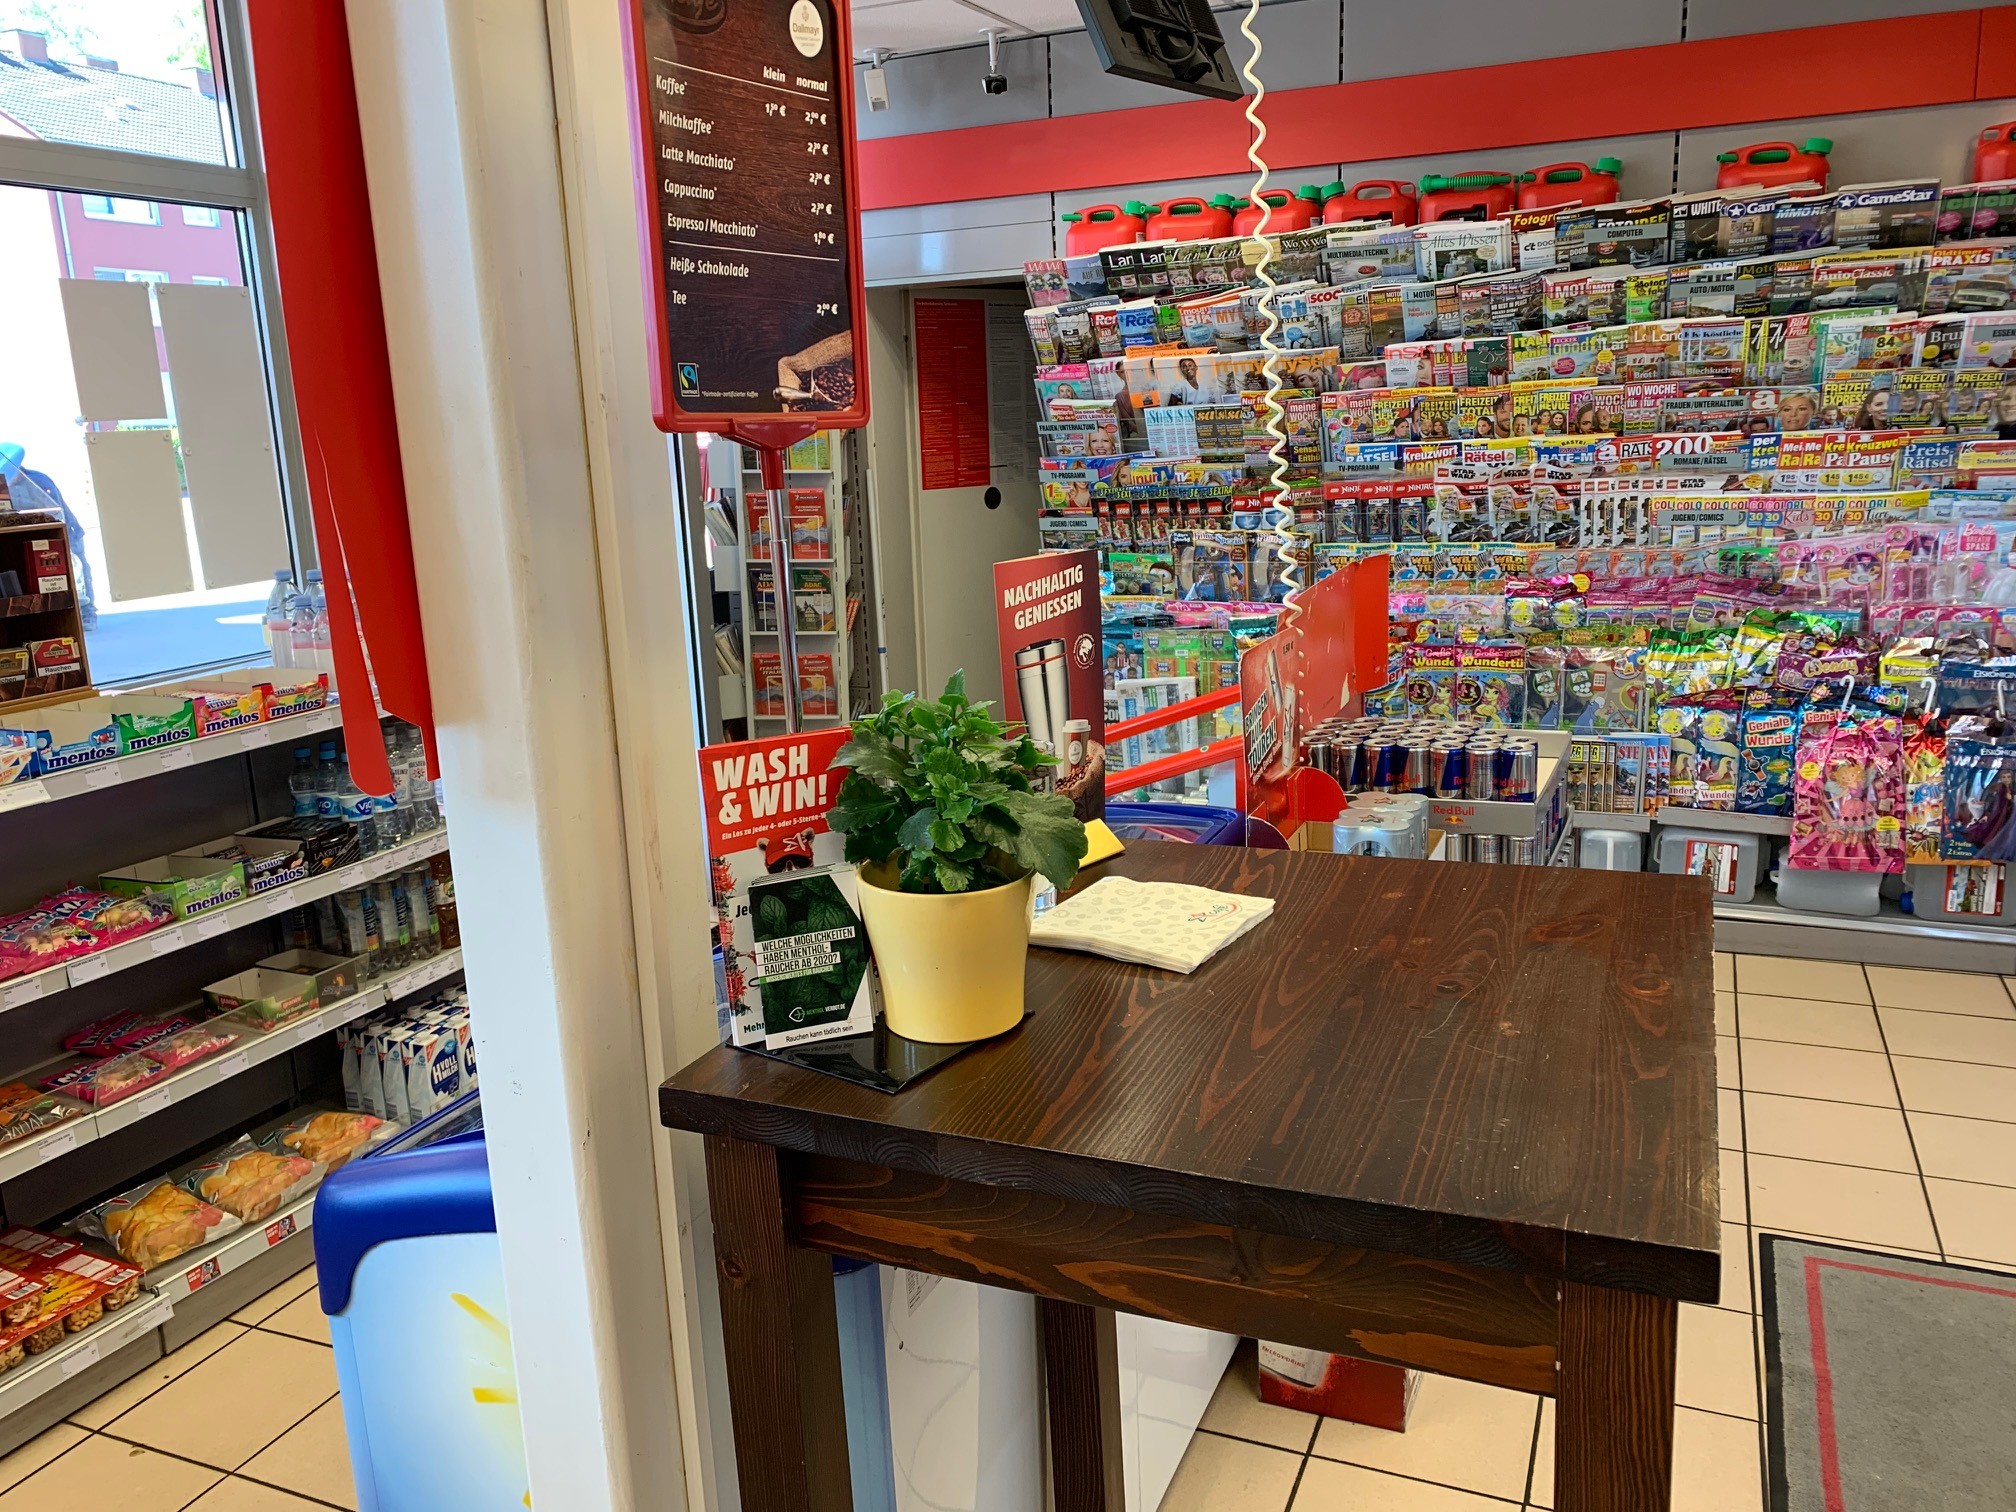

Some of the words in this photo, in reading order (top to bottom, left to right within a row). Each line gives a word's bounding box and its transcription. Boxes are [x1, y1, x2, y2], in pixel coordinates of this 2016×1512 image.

[792, 22, 820, 36] Dallmayr
[763, 65, 786, 83] klein
[796, 75, 828, 93] normal
[661, 144, 684, 163] Latte
[1858, 189, 1933, 207] GameStar
[1691, 200, 1722, 214] WHITE
[1607, 228, 1644, 239] COMPUTER
[1421, 235, 1455, 249] Altes
[1459, 234, 1499, 247] Wissen
[1326, 247, 1390, 259] MULTIMEDIA/TECHNIK
[1570, 247, 1589, 256] DOOM
[1932, 253, 1992, 266] PRAXIS
[670, 256, 695, 275] Heiße
[697, 259, 749, 278] Schokolade
[1413, 290, 1435, 299] MOTOR
[1689, 284, 1735, 294] AUTO/MOTOR
[672, 290, 687, 305] Tee
[1066, 301, 1112, 312] GRAVEL-SPEZIAL
[1789, 317, 1808, 328] Bild
[1876, 337, 1895, 348] 84
[1687, 366, 1742, 375] Blechkuchen
[1900, 373, 1947, 383] FREIZEIT
[1956, 372, 2004, 383] FREIZEIT
[1644, 383, 1677, 396] WOCHE
[1824, 382, 1870, 394] FREIZEIT
[1322, 395, 1336, 404] Lisa
[1539, 392, 1571, 402] FREIZEIT
[1290, 403, 1316, 412] meine
[1373, 399, 1411, 410] FREIZEIT
[1420, 401, 1457, 411] FREIZEIT
[1460, 406, 1495, 416] TOTAL
[1539, 401, 1571, 411] REVUE
[1665, 399, 1744, 410] FRAUEN/UNTERHALTUNG
[1289, 411, 1318, 421] WOCHE
[1420, 410, 1457, 420] SPASS
[1039, 423, 1096, 433] FRAUEN/UNTERHALTUNG
[1753, 436, 1777, 447] Der
[1403, 445, 1458, 461] Kreuzwort
[1465, 450, 1505, 463] Rätsel
[1904, 443, 1954, 457] Preis-
[1673, 455, 1728, 466] ROMANE/RÄTSEL
[1902, 455, 1955, 469] Rätsel
[1338, 464, 1380, 473] TV-PROGRAMM
[1051, 471, 1086, 480] TV-PROGRAMM
[1671, 513, 1724, 523] JUGEND/COMICS
[1766, 512, 1779, 522] 30
[1784, 509, 1809, 526] Kids
[1847, 512, 1862, 521] 30
[1050, 519, 1088, 529] JUGEND/COMICS
[1962, 522, 1997, 537] Barbie
[1965, 542, 1991, 551] SPASS
[1004, 564, 1084, 609] NACHHALTIG
[1013, 589, 1083, 630] GENIESSEN
[44, 664, 72, 674] Rauchen
[1803, 658, 1859, 678] Wendy
[1893, 695, 1901, 706] 1
[270, 698, 322, 717] mentos
[205, 711, 260, 733] mentos
[1747, 716, 1792, 733] Geniale
[129, 728, 191, 751] mentos
[1249, 719, 1277, 771] TOUREN!
[48, 744, 117, 769] mentos
[712, 744, 808, 792] WASH
[1400, 773, 1421, 784] Bull
[718, 792, 742, 825] &
[749, 774, 828, 819] WIN!
[1433, 804, 1454, 816] Red
[1454, 805, 1475, 817] Bull
[722, 832, 732, 840] Ein
[732, 830, 744, 838] Los
[752, 824, 769, 834] jeder
[778, 820, 792, 828] oder
[253, 866, 304, 892] mentos
[185, 886, 242, 917] mentos
[761, 937, 793, 952] WELCHE
[763, 952, 790, 964] HABEN
[790, 944, 829, 959] MENTHOL-
[764, 960, 801, 975] RAUCHER
[801, 957, 812, 969] AB
[813, 953, 838, 967] 2020?
[785, 1032, 810, 1043] Rauchen
[810, 1030, 823, 1039] kann
[823, 1025, 841, 1036] tödlich
[432, 1064, 443, 1084] H
[440, 1054, 458, 1067] VOLL
[440, 1063, 459, 1077] MILCH
